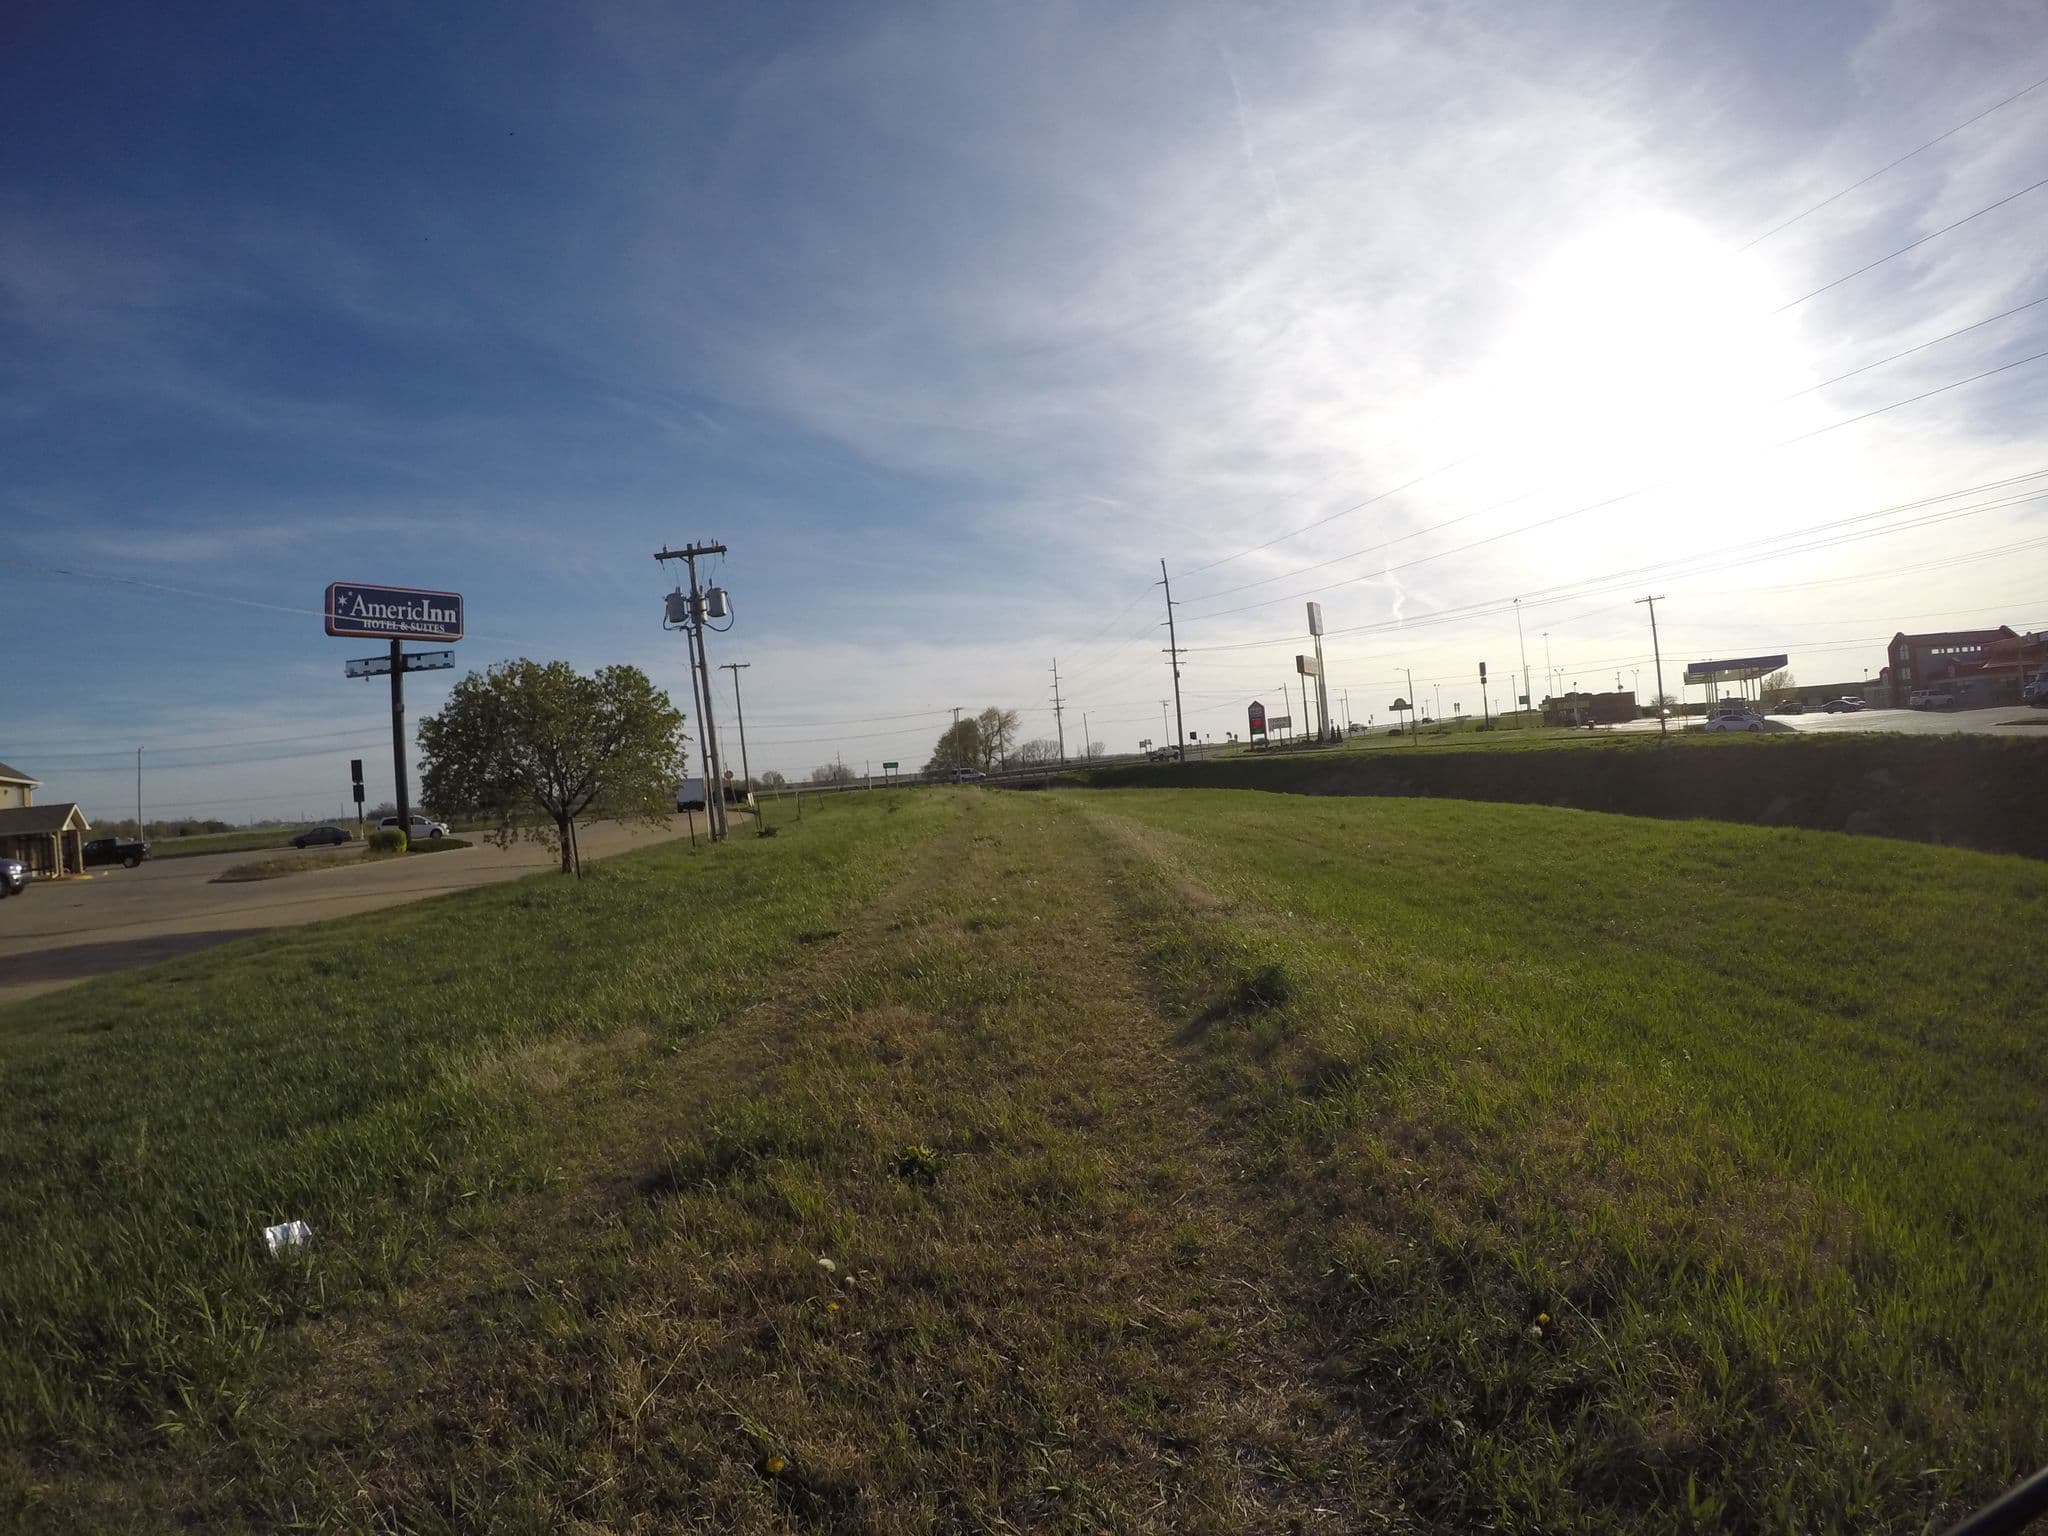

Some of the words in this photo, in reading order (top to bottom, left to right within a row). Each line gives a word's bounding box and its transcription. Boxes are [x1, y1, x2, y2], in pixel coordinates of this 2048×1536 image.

[350, 594, 457, 623] AmericInn
[363, 620, 399, 630] HOTEL
[400, 621, 408, 631] &
[410, 622, 445, 633] SUITES
